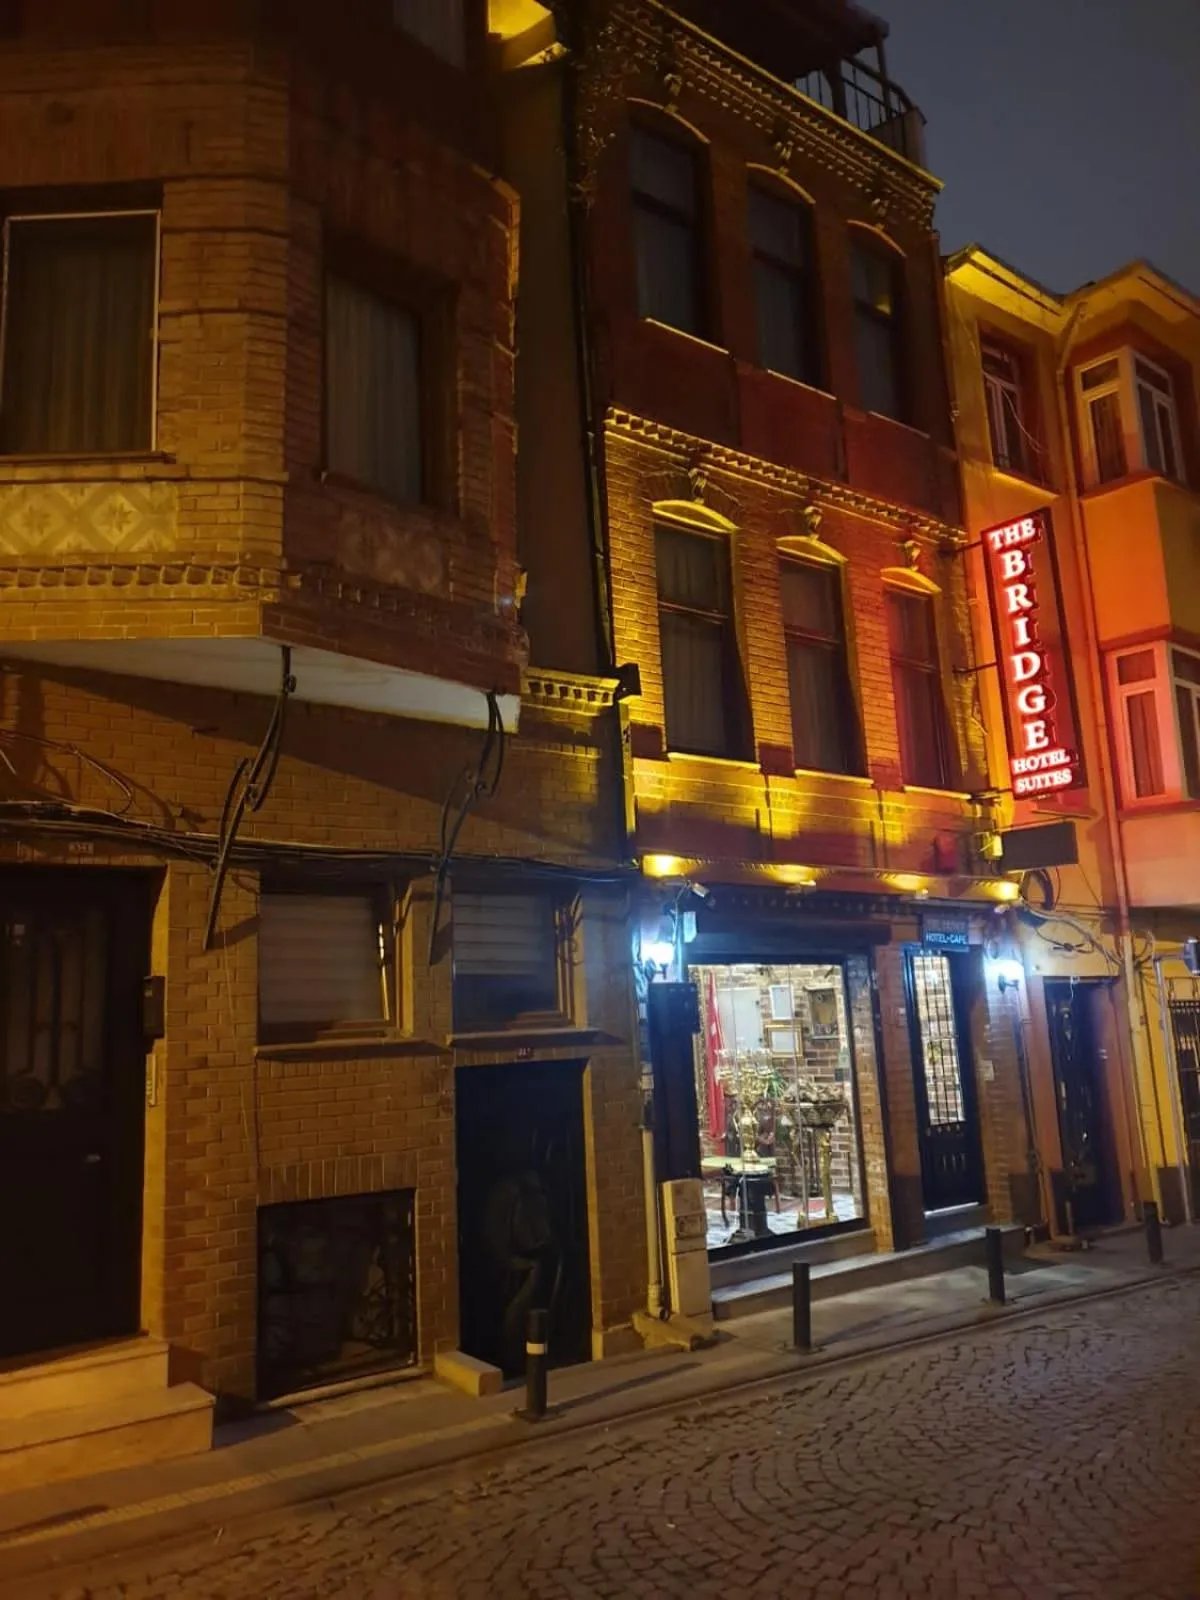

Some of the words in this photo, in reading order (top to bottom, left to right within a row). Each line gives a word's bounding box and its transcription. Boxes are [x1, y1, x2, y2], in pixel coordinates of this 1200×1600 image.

[988, 517, 1036, 549] THE
[1001, 549, 1050, 751] BRIDGE
[1012, 749, 1071, 775] HOTEL
[1014, 769, 1073, 795] SUITES
